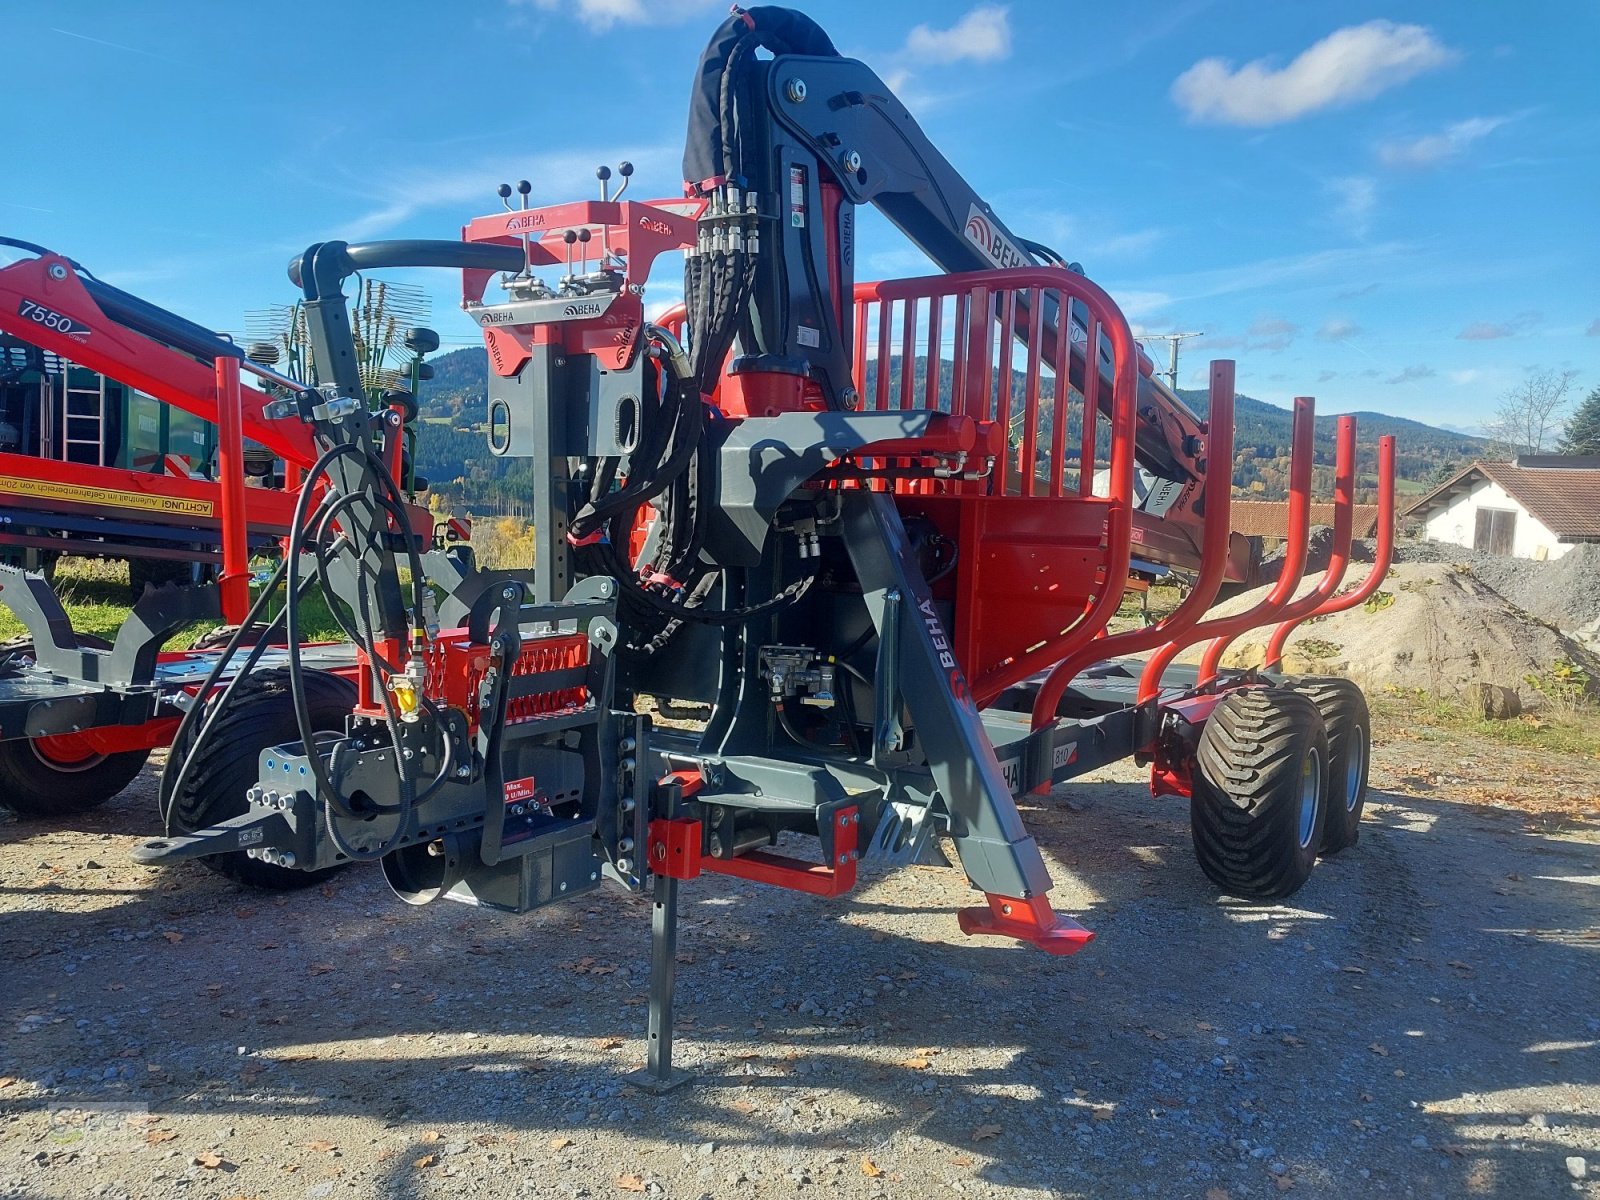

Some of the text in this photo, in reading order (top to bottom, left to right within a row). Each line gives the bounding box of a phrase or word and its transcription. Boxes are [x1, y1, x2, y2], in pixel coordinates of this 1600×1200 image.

[520, 214, 546, 228] BEHA
[843, 212, 852, 244] BEHA
[990, 234, 1027, 269] BEH
[20, 299, 72, 333] 7550
[493, 311, 514, 323] BEHA
[577, 303, 601, 315] BEHA
[620, 317, 637, 349] BEHA
[492, 344, 505, 372] BEHA
[19, 482, 36, 490] von
[37, 482, 106, 500] Gefahrenbereich
[107, 491, 118, 500] im
[118, 491, 158, 506] Aufenthalt
[1153, 486, 1174, 507] BEHA
[161, 500, 210, 513] ACHTUNG!
[917, 598, 955, 668] BEHA
[1055, 748, 1069, 766] 810
[1001, 761, 1019, 789] HA
[506, 783, 523, 791] Max.
[510, 789, 532, 799] U/Min.
